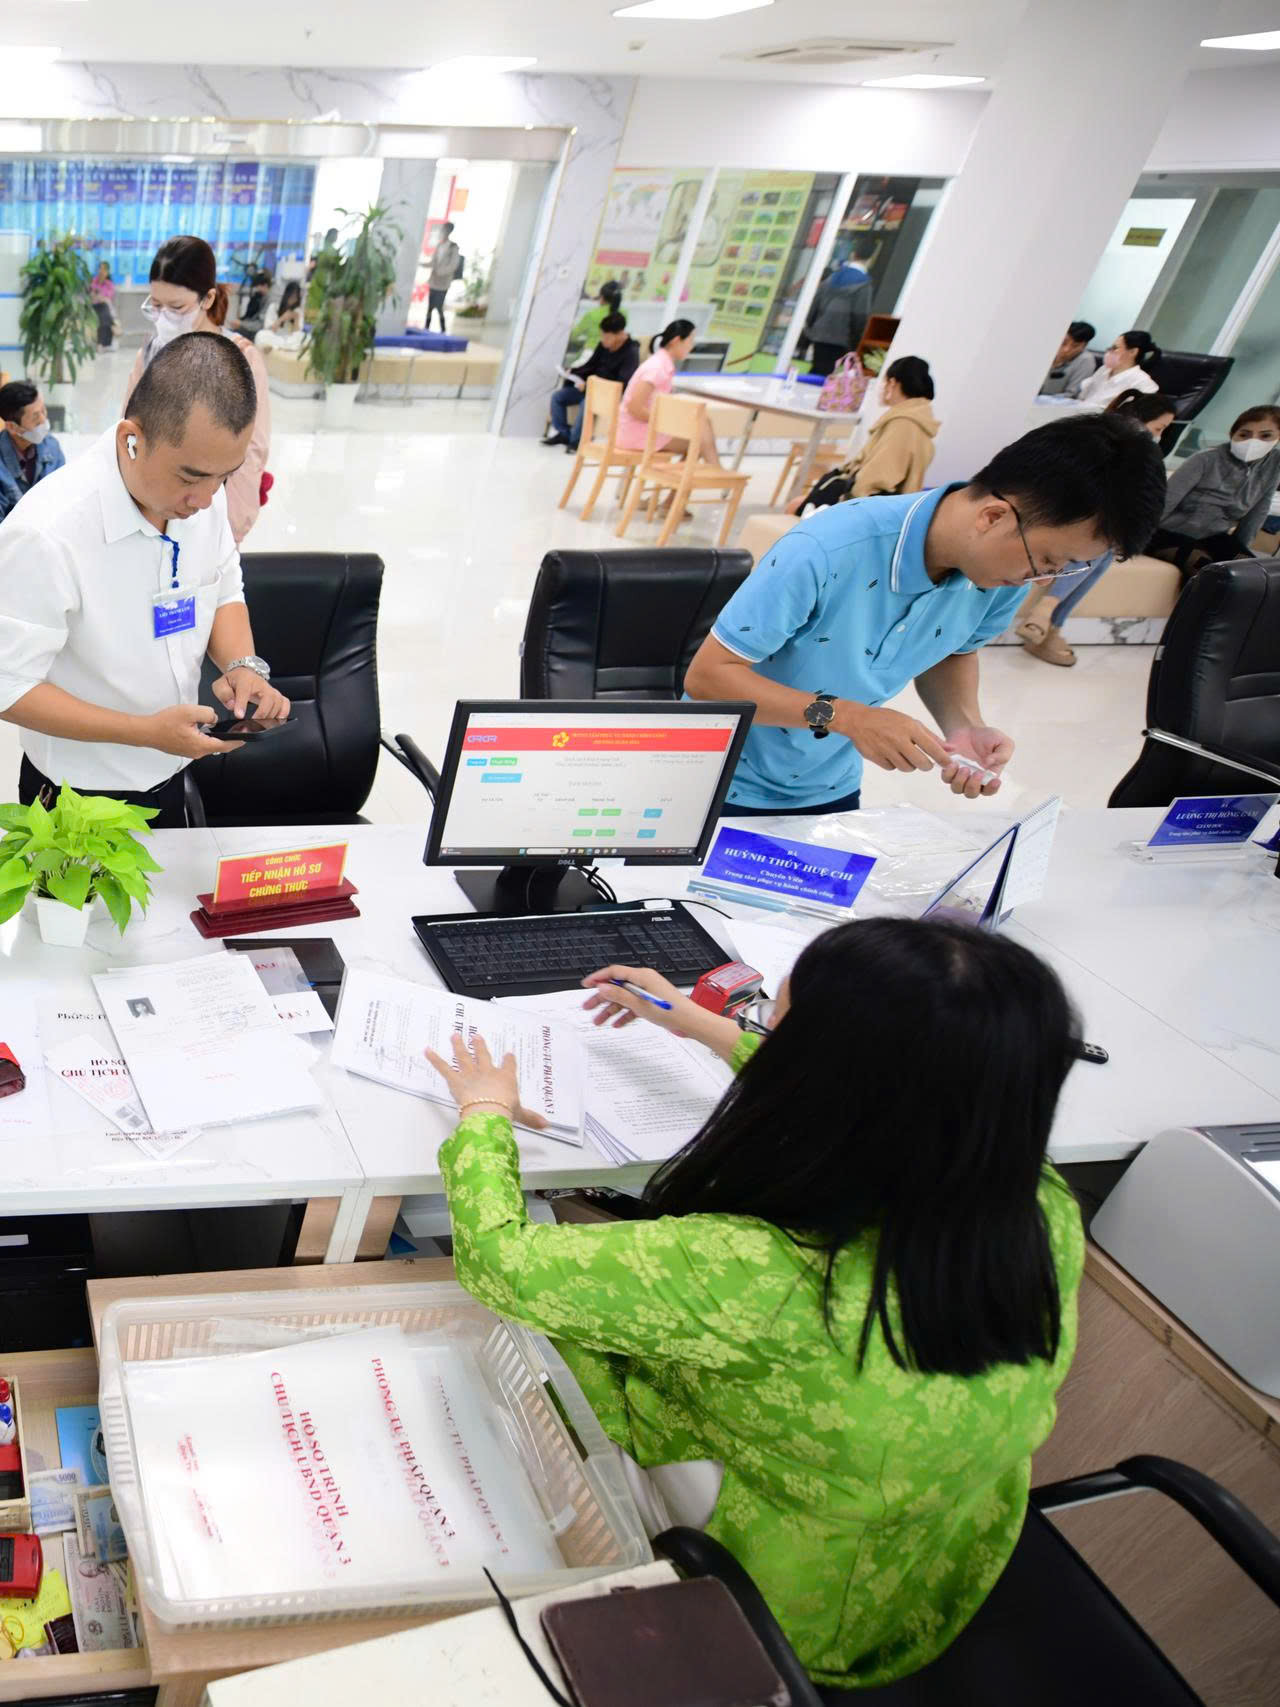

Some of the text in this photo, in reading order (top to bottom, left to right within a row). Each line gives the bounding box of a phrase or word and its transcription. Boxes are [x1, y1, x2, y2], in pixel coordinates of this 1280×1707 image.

[241, 868, 262, 884] TIẾP
[263, 865, 291, 881] NHẬN
[308, 862, 322, 874] SƠ
[803, 864, 828, 878] HUỆ
[830, 870, 854, 881] CHI
[297, 1456, 323, 1501] UBND
